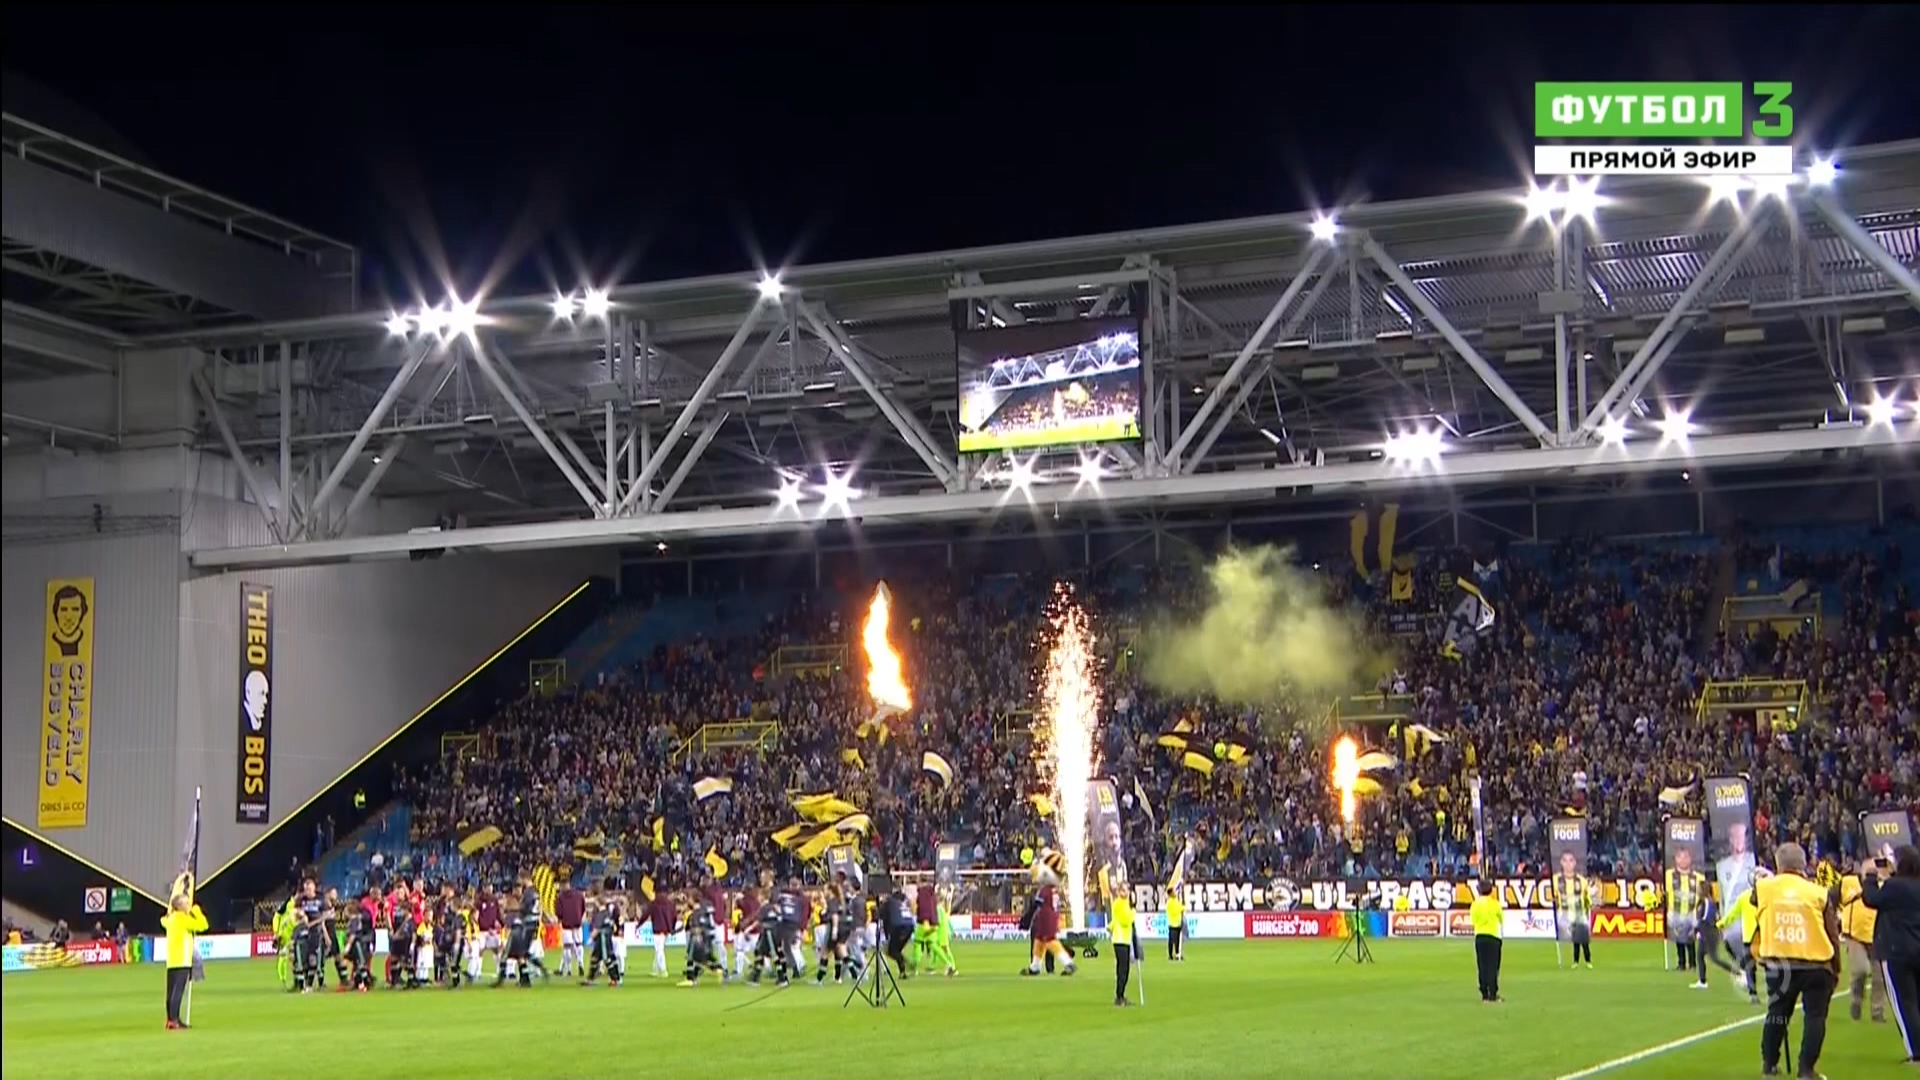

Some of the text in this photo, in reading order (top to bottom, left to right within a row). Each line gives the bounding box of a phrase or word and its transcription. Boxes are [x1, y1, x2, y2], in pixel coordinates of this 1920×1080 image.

[246, 591, 268, 665] THEO
[65, 662, 86, 785] CHARLY
[244, 736, 265, 795] BOS
[1872, 821, 1899, 836] VITO
[22, 848, 34, 864] L
[1394, 914, 1438, 927] ABCO
[1775, 911, 1803, 925] FOTO
[1299, 920, 1319, 935] ZOO
[1774, 925, 1807, 944] 480
